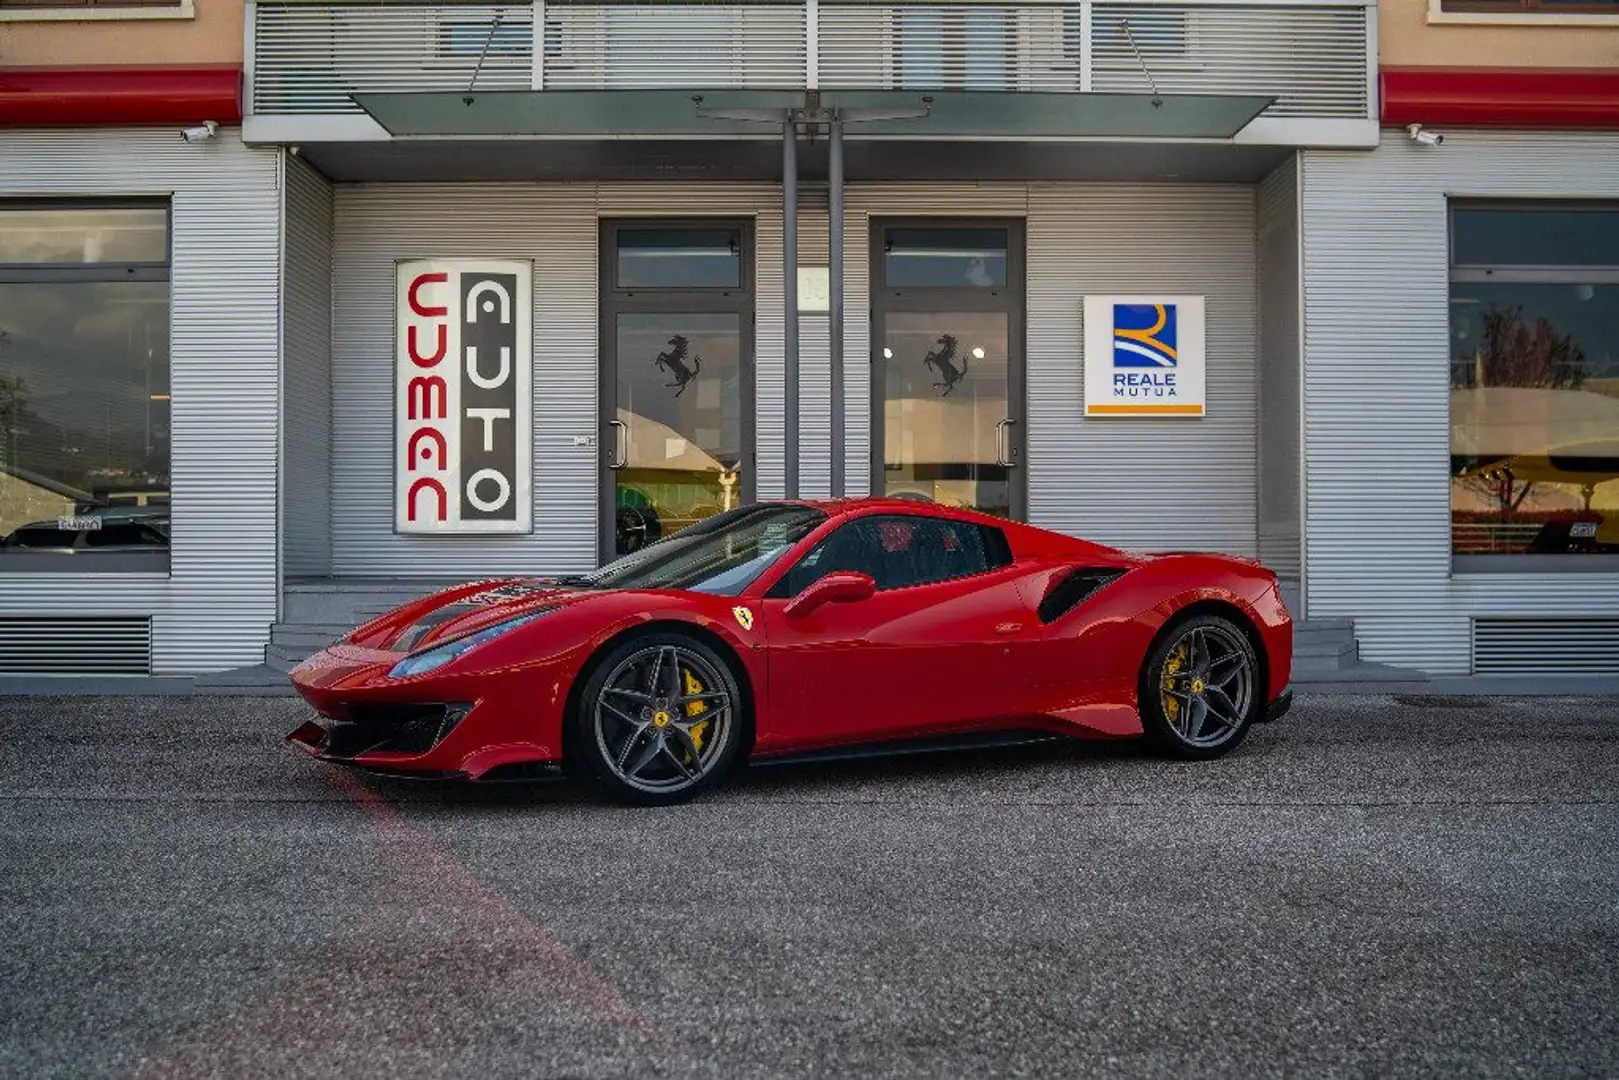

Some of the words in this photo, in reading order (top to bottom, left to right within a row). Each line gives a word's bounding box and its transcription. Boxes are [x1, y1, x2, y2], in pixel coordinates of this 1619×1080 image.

[1113, 373, 1176, 386] REALE
[466, 280, 511, 512] AUTO
[1113, 388, 1177, 397] MUTUA
